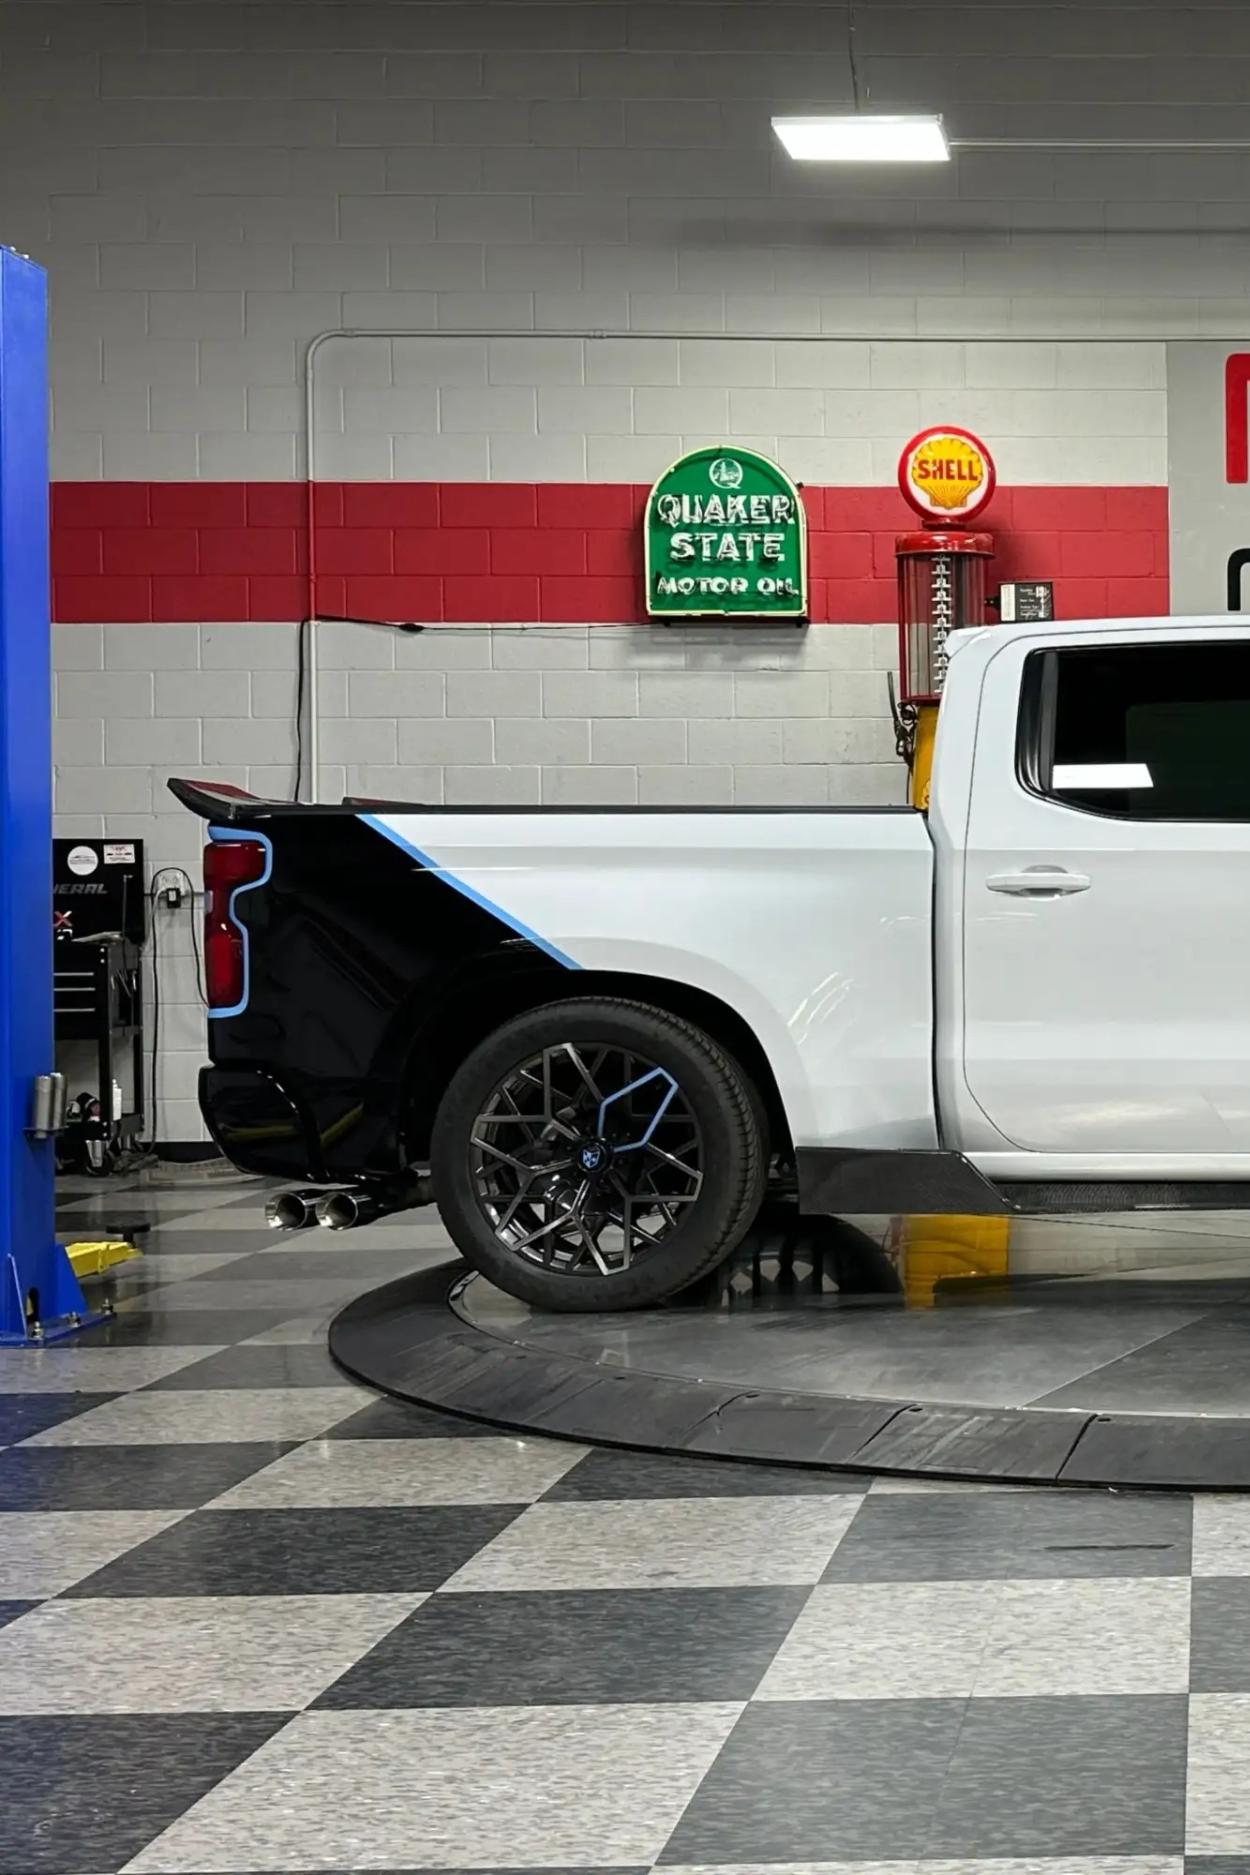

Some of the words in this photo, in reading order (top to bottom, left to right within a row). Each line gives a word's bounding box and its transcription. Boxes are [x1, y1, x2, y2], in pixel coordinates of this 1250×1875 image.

[917, 459, 978, 481] SHELL
[657, 494, 796, 528] QUAKER
[670, 532, 785, 561] STATE
[656, 576, 748, 595] MOTOR
[757, 576, 799, 595] OIL
